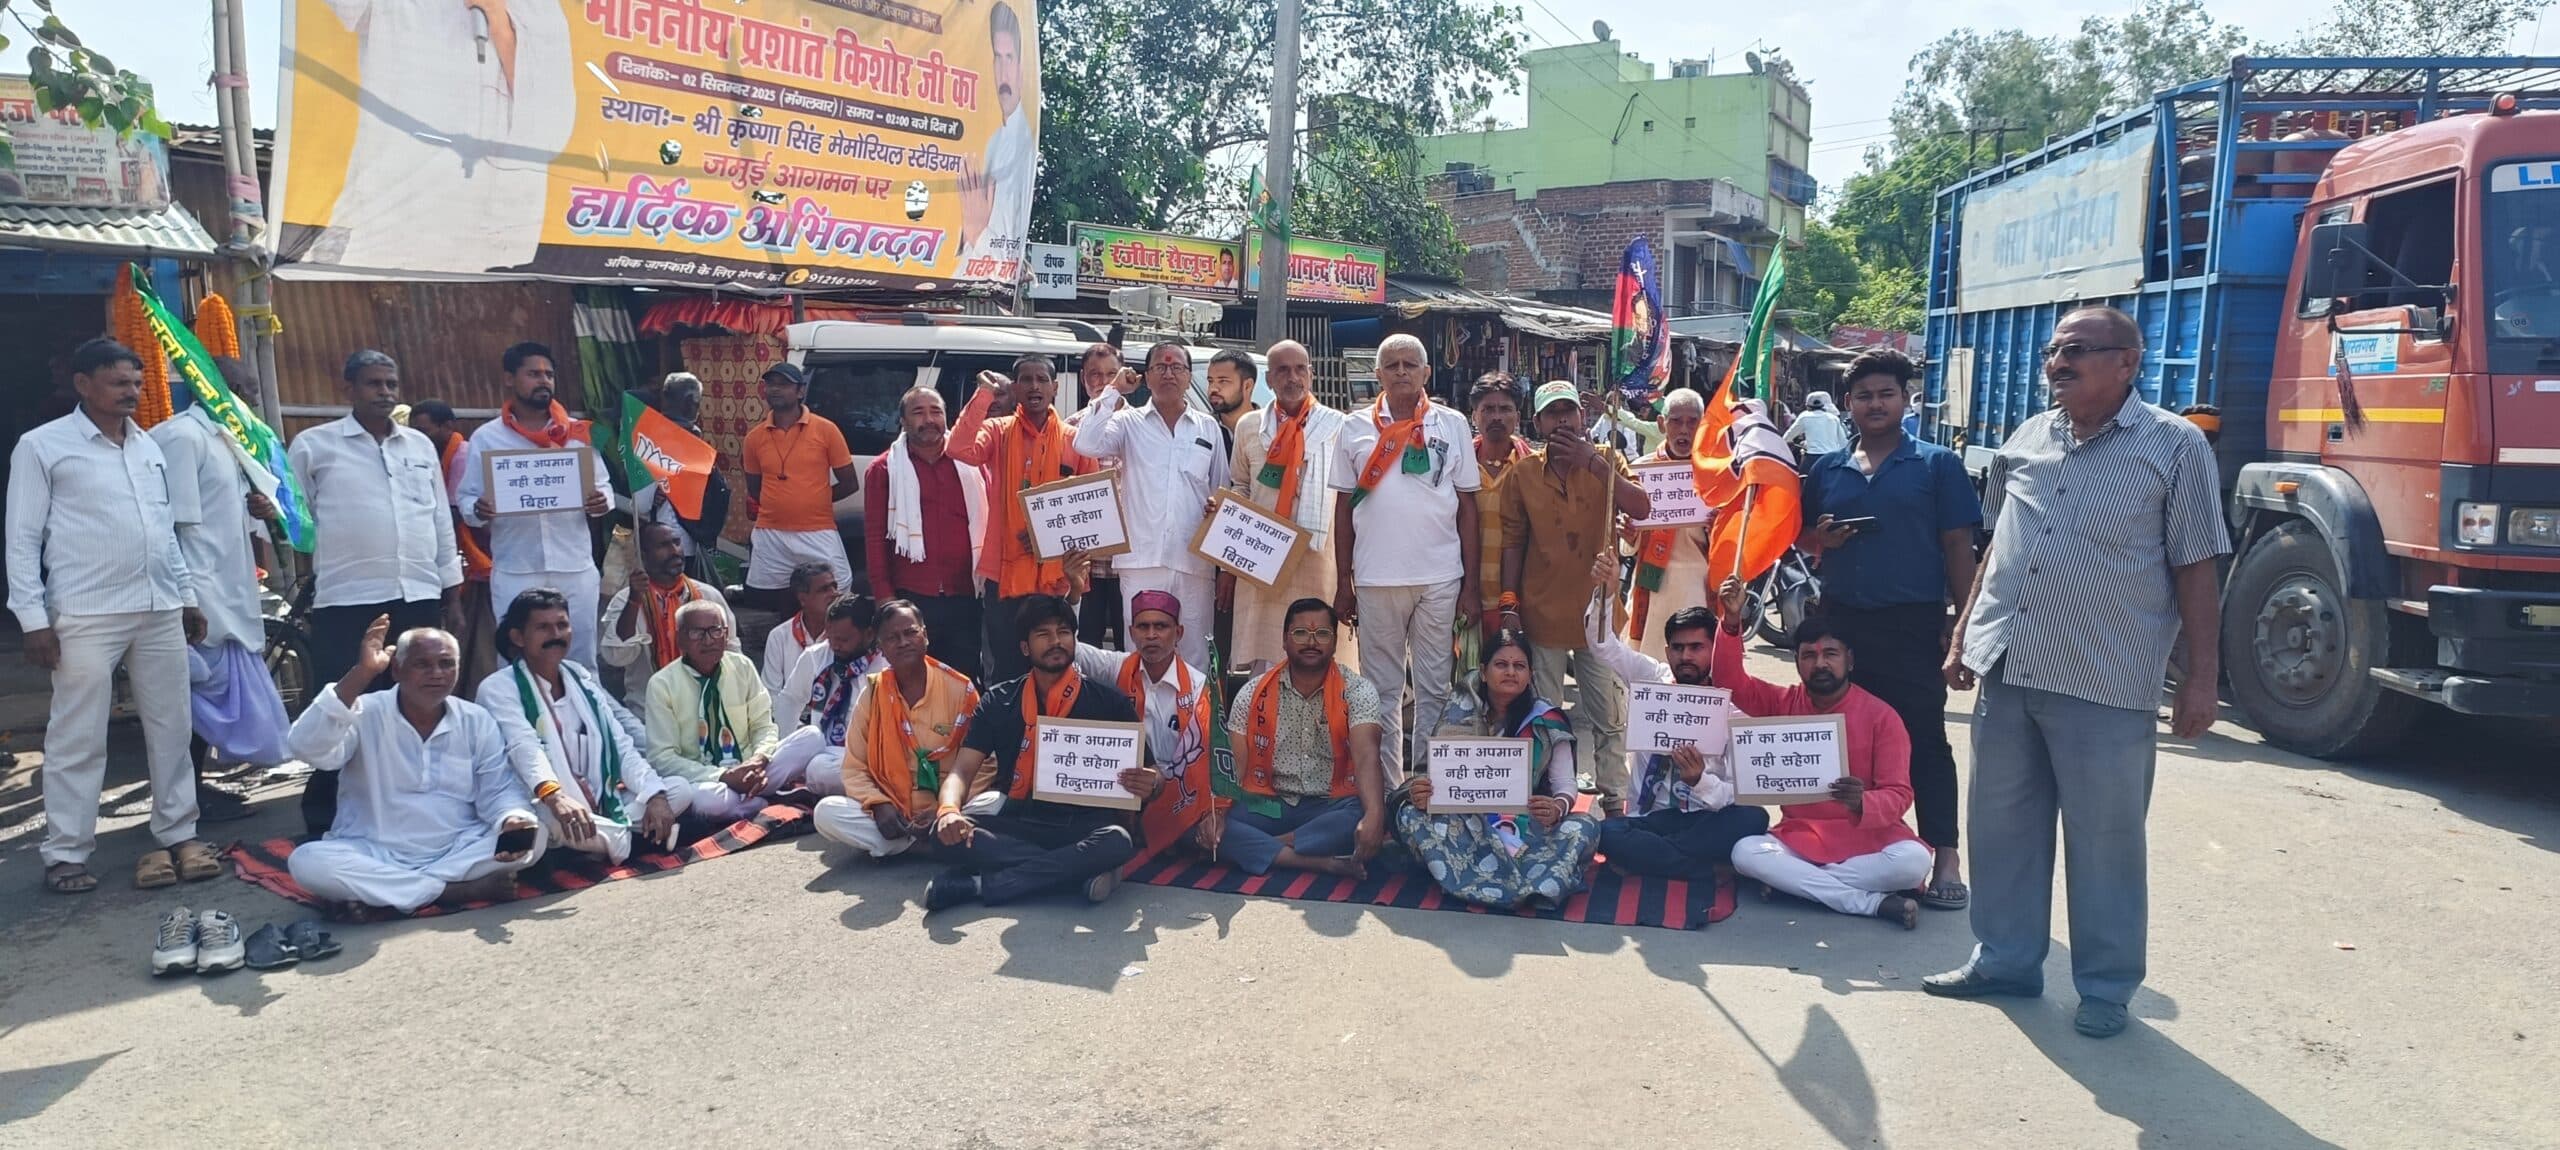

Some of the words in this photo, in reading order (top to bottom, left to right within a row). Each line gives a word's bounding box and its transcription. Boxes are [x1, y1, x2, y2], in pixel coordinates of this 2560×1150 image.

[586, 0, 736, 59] माननीय
[739, 17, 828, 79] प्रशांत
[833, 28, 914, 97] किशोर
[916, 51, 948, 104] जी
[951, 69, 979, 111] का
[682, 74, 697, 87] 02
[700, 71, 751, 95] सितम्बर
[752, 87, 776, 102] 2025
[779, 87, 838, 117] (मंगलवार)
[846, 105, 874, 121] समय
[885, 113, 910, 128] 02:00
[911, 118, 929, 132] बजे
[930, 119, 947, 134] दिन
[948, 121, 959, 136] में
[693, 105, 723, 136] श्री
[727, 117, 782, 147] कृष्णा
[786, 120, 826, 155] सिंह
[828, 129, 906, 165] मेमोरियल
[907, 142, 963, 173] स्टेडियम
[703, 151, 774, 191] जमुई
[773, 163, 862, 195] आगमन
[865, 176, 893, 200] पर
[2518, 162, 2560, 186] L.
[567, 174, 738, 238] हार्दिक
[738, 196, 946, 263] अभिनन्दन
[604, 255, 644, 270] अधिक
[645, 259, 697, 276] जानकारी
[697, 263, 711, 277] के
[712, 265, 737, 279] लिए
[1043, 253, 1065, 268] दीपक
[1109, 240, 1162, 271] रंजीत
[1165, 245, 1217, 282] सैलून
[1051, 273, 1073, 288] दुकान
[1333, 253, 1378, 293] स्वीट्स
[496, 459, 510, 470] माँ
[515, 460, 529, 469] का
[533, 458, 574, 468] अपमान
[508, 475, 529, 487] नही
[533, 475, 565, 486] सहेगा
[1650, 473, 1664, 482] का
[520, 494, 559, 508] बिहार
[1030, 496, 1046, 511] माँ
[1048, 496, 1064, 508] का
[1067, 487, 1110, 504] अपमान
[1648, 488, 1664, 502] ही
[1045, 513, 1067, 528] नही
[1069, 509, 1103, 525] सहेगा
[1222, 504, 1239, 517] माँ
[1239, 512, 1254, 525] का
[1254, 520, 1292, 544] अपमान
[1224, 525, 1245, 541] नही
[1244, 535, 1275, 556] सहेगा
[1221, 545, 1258, 572] बिहार
[1634, 687, 1651, 701] माँ
[1655, 691, 1672, 703] का
[1676, 693, 1725, 706] अपमान
[1645, 709, 1668, 724] नही
[1672, 711, 1711, 726] सहेगा
[1041, 728, 1059, 743] माँ
[1063, 733, 1081, 744] का
[1085, 735, 1135, 749] अपमान
[1735, 729, 1753, 745] माँ
[1757, 732, 1776, 744] का
[1781, 730, 1833, 743] अपमान
[1053, 751, 1078, 767] नही
[1081, 754, 1121, 769] सहेगा
[1432, 743, 1450, 757] माँ
[1453, 747, 1471, 758] का
[1475, 747, 1524, 758] अपमान
[1750, 752, 1776, 768] नही
[1780, 751, 1822, 767] सहेगा
[1444, 764, 1470, 779] नही
[1473, 764, 1512, 779] सहेगा
[1055, 772, 1117, 792] हिन्दुस्तान
[1756, 774, 1820, 792] हिन्दुस्तान
[1448, 785, 1508, 803] हिन्दुस्तान
